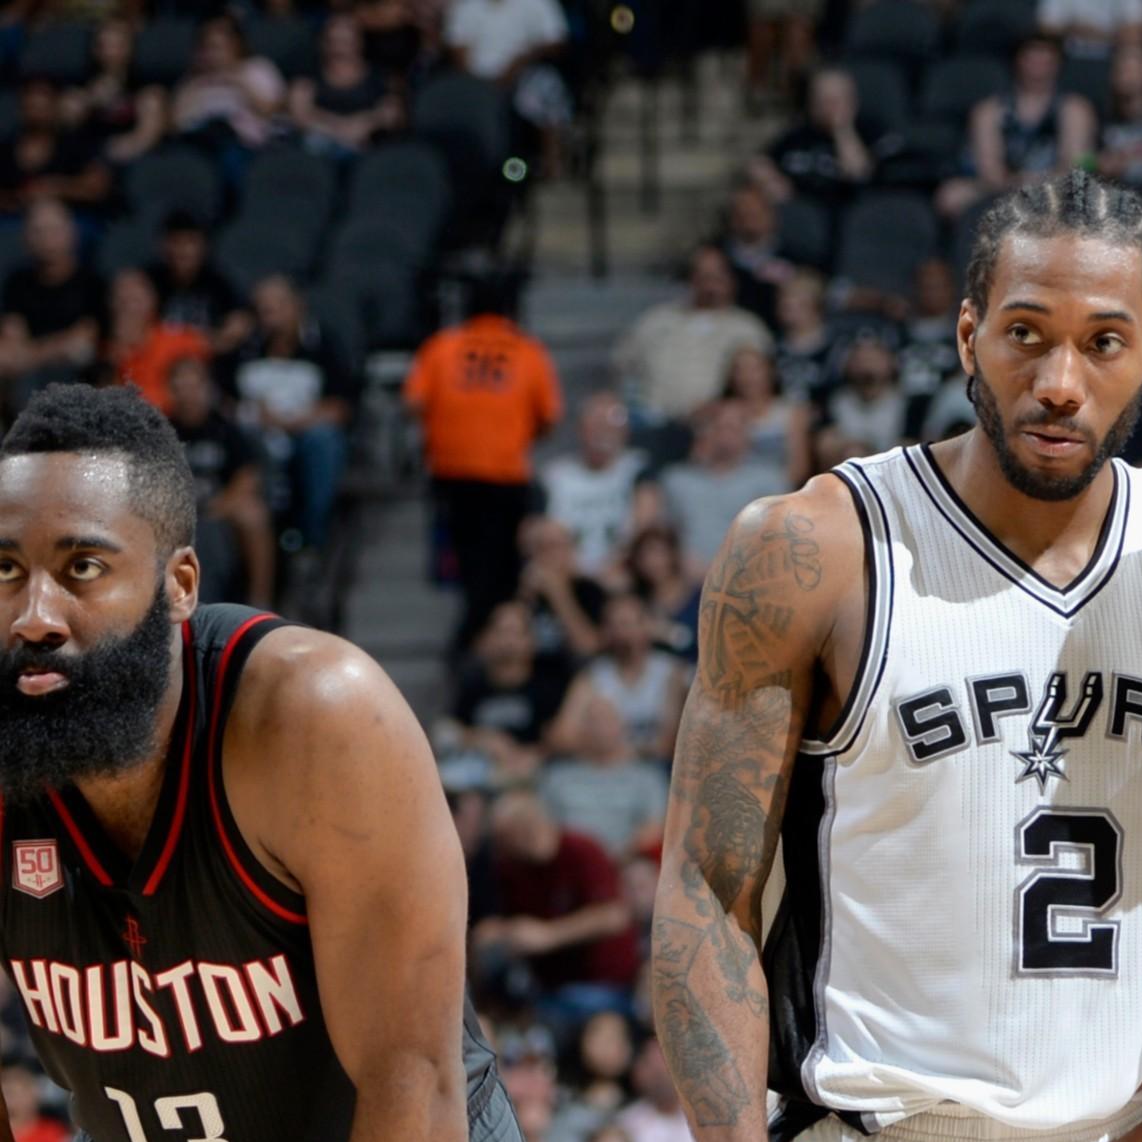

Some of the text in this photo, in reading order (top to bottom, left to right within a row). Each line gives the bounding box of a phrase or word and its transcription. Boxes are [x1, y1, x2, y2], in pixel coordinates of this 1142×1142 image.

[20, 847, 54, 874] 50
[1012, 804, 1125, 980] 2
[9, 953, 305, 1059] HOUSTON
